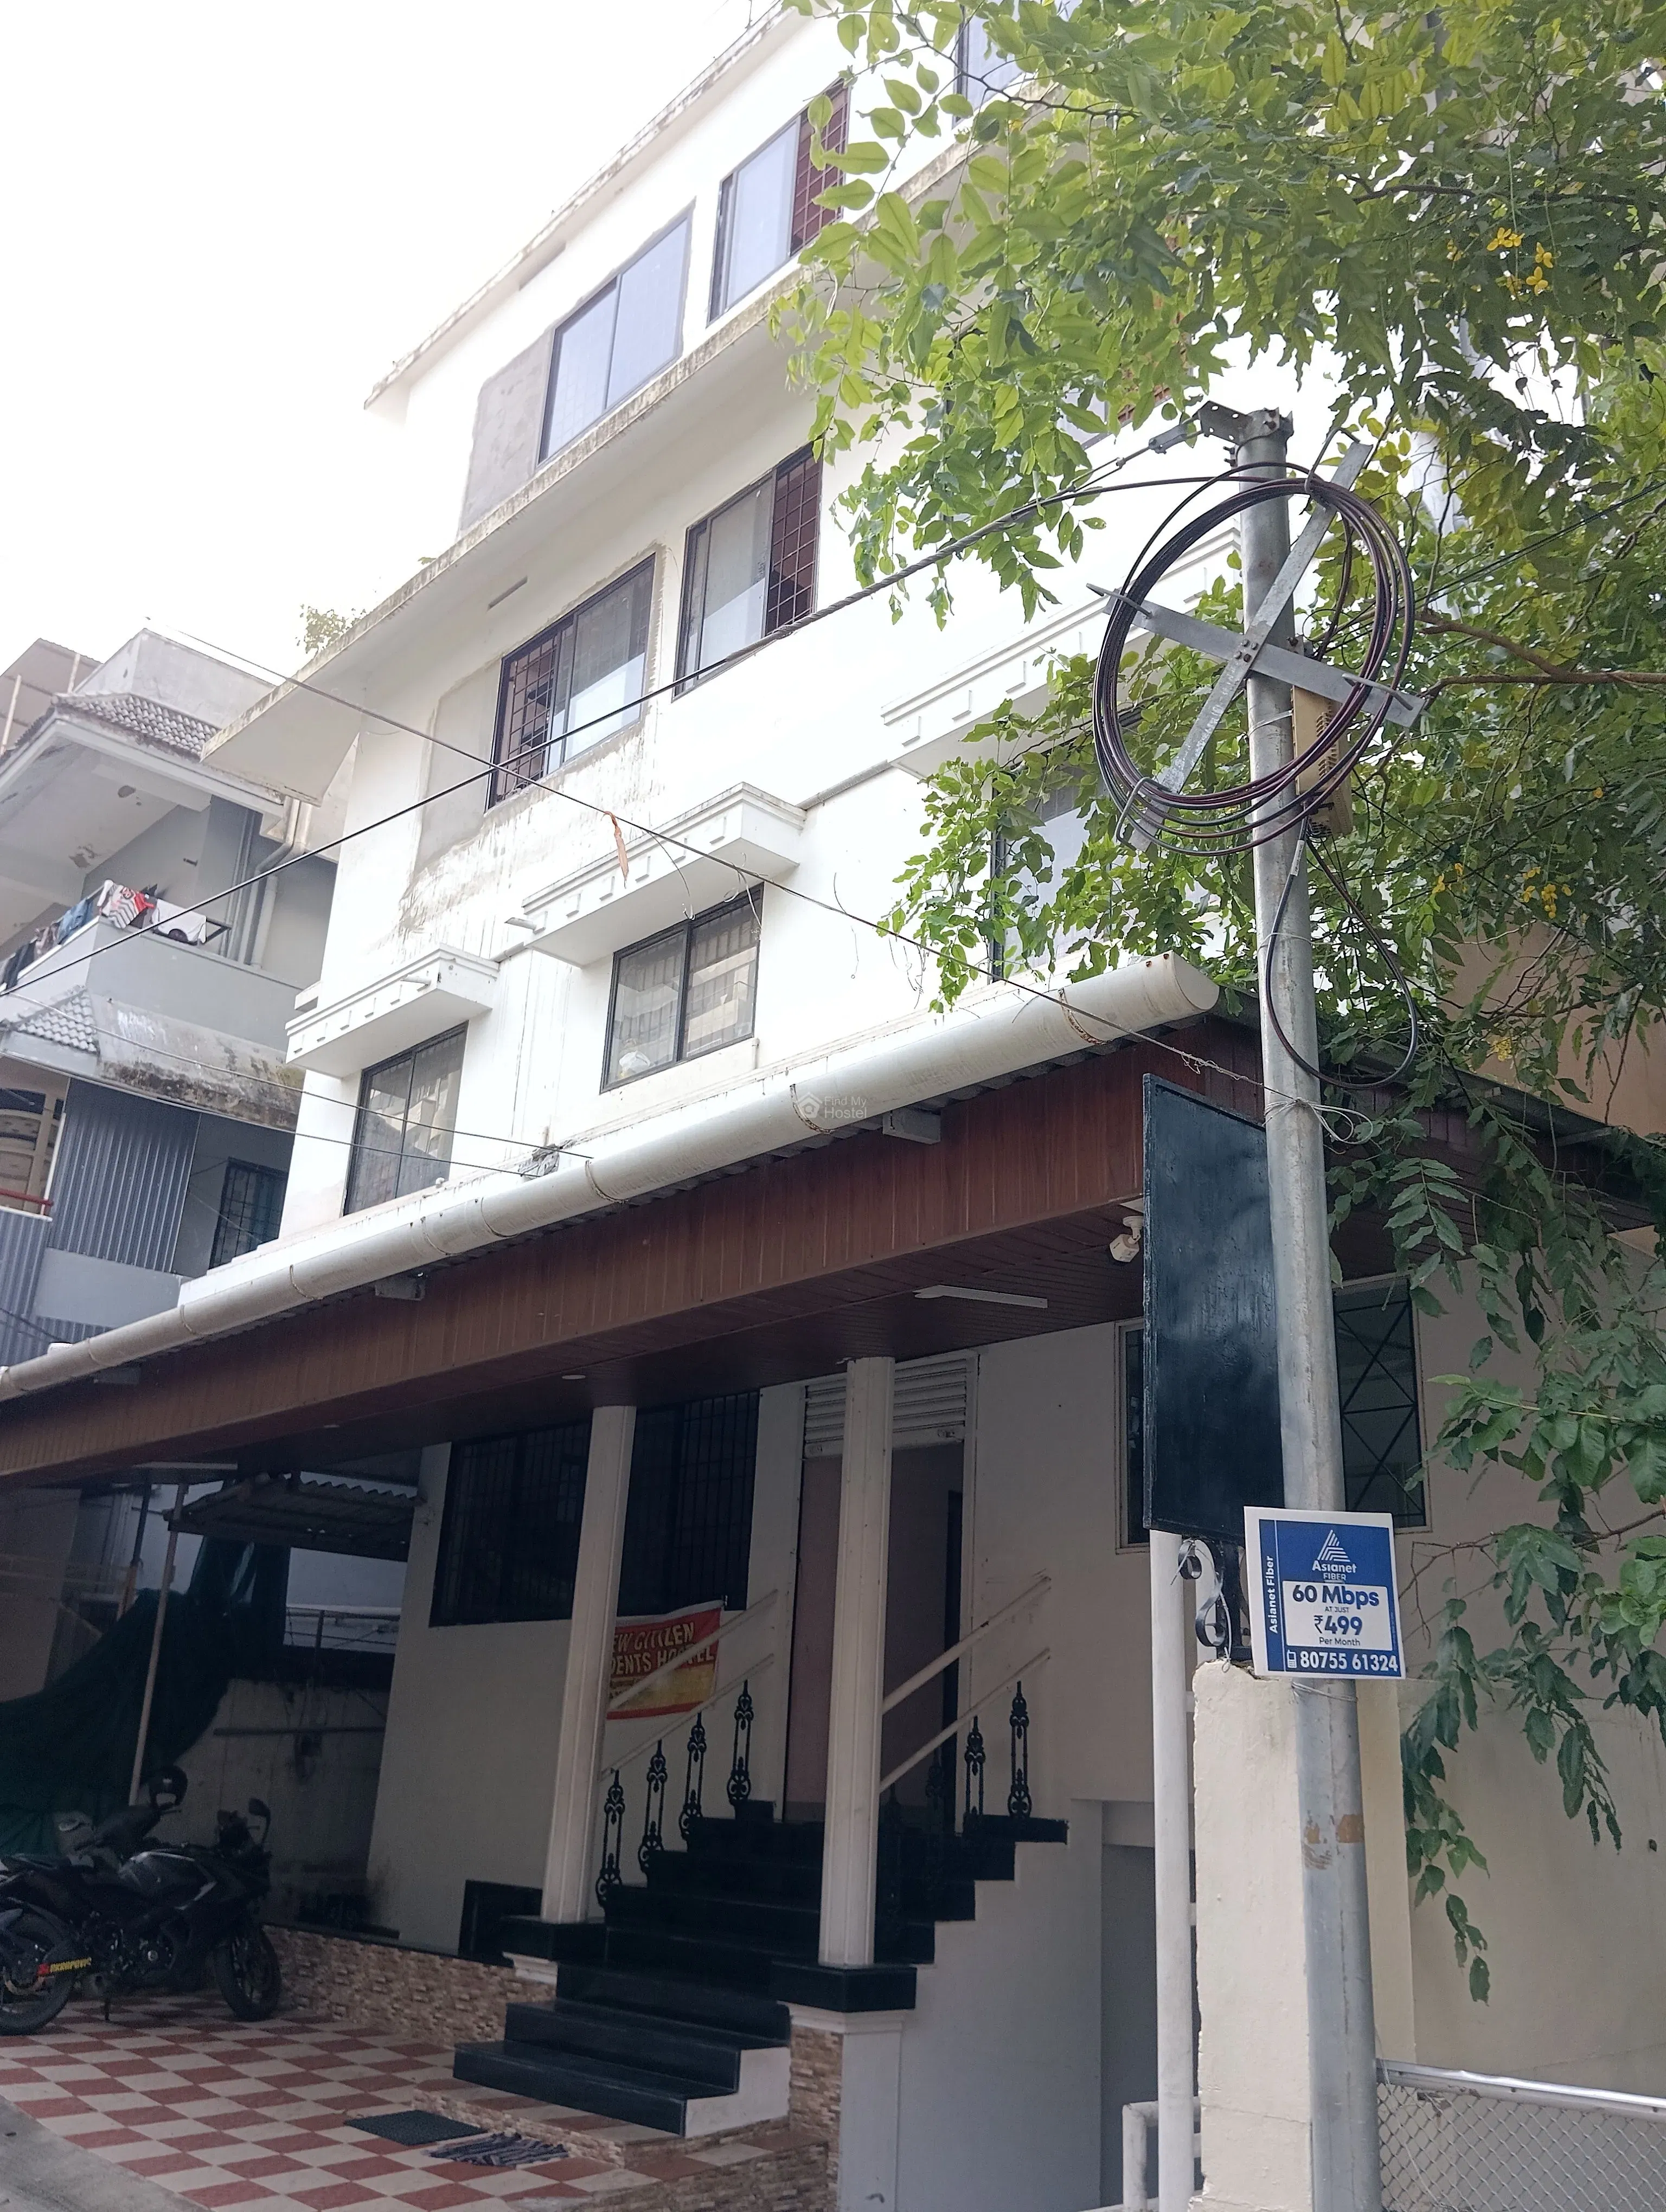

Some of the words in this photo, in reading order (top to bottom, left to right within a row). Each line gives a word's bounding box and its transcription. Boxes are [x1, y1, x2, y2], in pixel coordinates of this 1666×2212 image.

[1265, 1555, 1276, 1586] Fiber
[1312, 1560, 1357, 1573] Asianet
[1292, 1585, 1317, 1603] 60
[1322, 1585, 1379, 1610] Mbps
[1267, 1589, 1278, 1634] Asianet
[1335, 1638, 1361, 1646] Month
[1299, 1650, 1348, 1669] 80755
[1351, 1654, 1399, 1672] 61324
